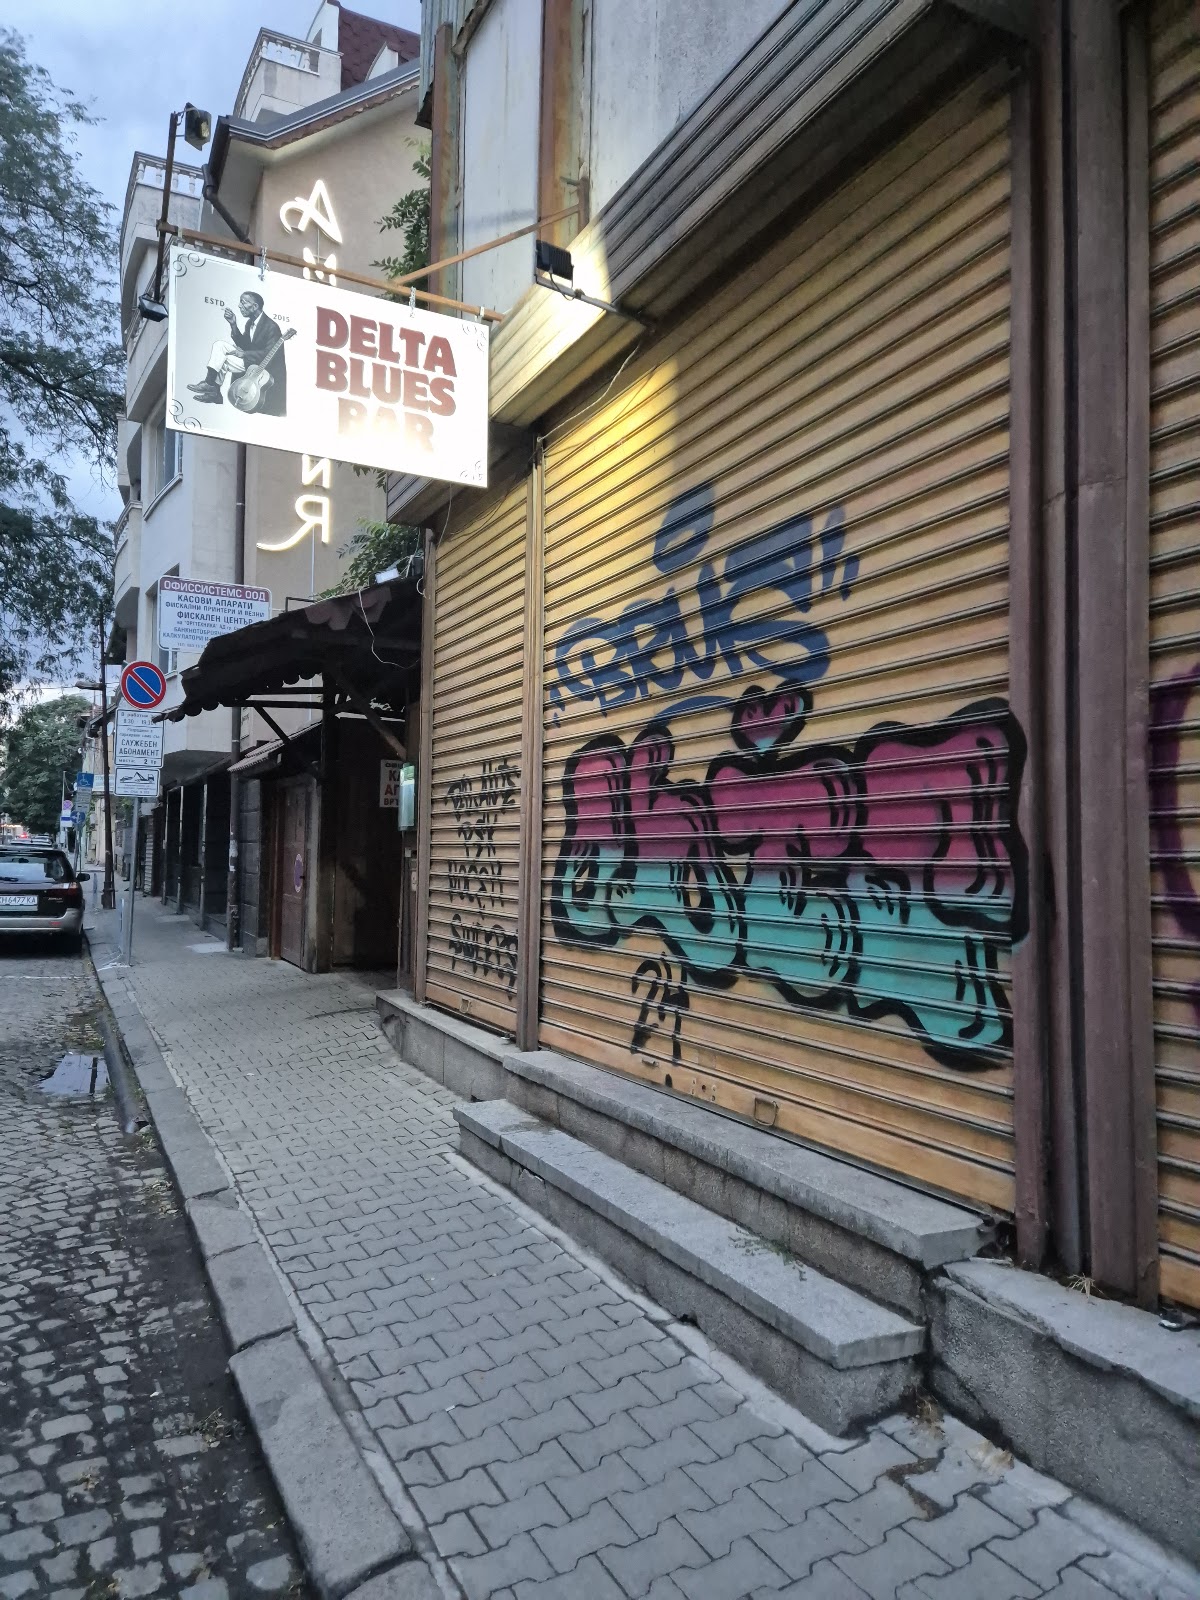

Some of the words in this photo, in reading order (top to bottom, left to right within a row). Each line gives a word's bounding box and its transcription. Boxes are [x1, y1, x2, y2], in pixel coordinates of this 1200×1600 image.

[204, 296, 225, 307] ESTD
[273, 314, 290, 323] 2015
[316, 306, 457, 378] DELTA
[315, 349, 457, 417] BLUES
[337, 396, 435, 453] BAR
[163, 580, 242, 598] ОФИССИСТЕМС
[245, 590, 266, 601] ООД
[165, 601, 202, 611] ФИСКАЛНИ
[203, 605, 236, 615] ПРИНТЕРИ
[177, 594, 212, 606] КАСОВИ
[215, 599, 253, 610] АПАРАТИ
[176, 610, 221, 623] ФИСКАЛЕН
[223, 615, 253, 626] ЦЕНТЪР
[121, 739, 158, 748] СЛУЖЕБЕН
[118, 747, 160, 757] АБОНАМЕНТ
